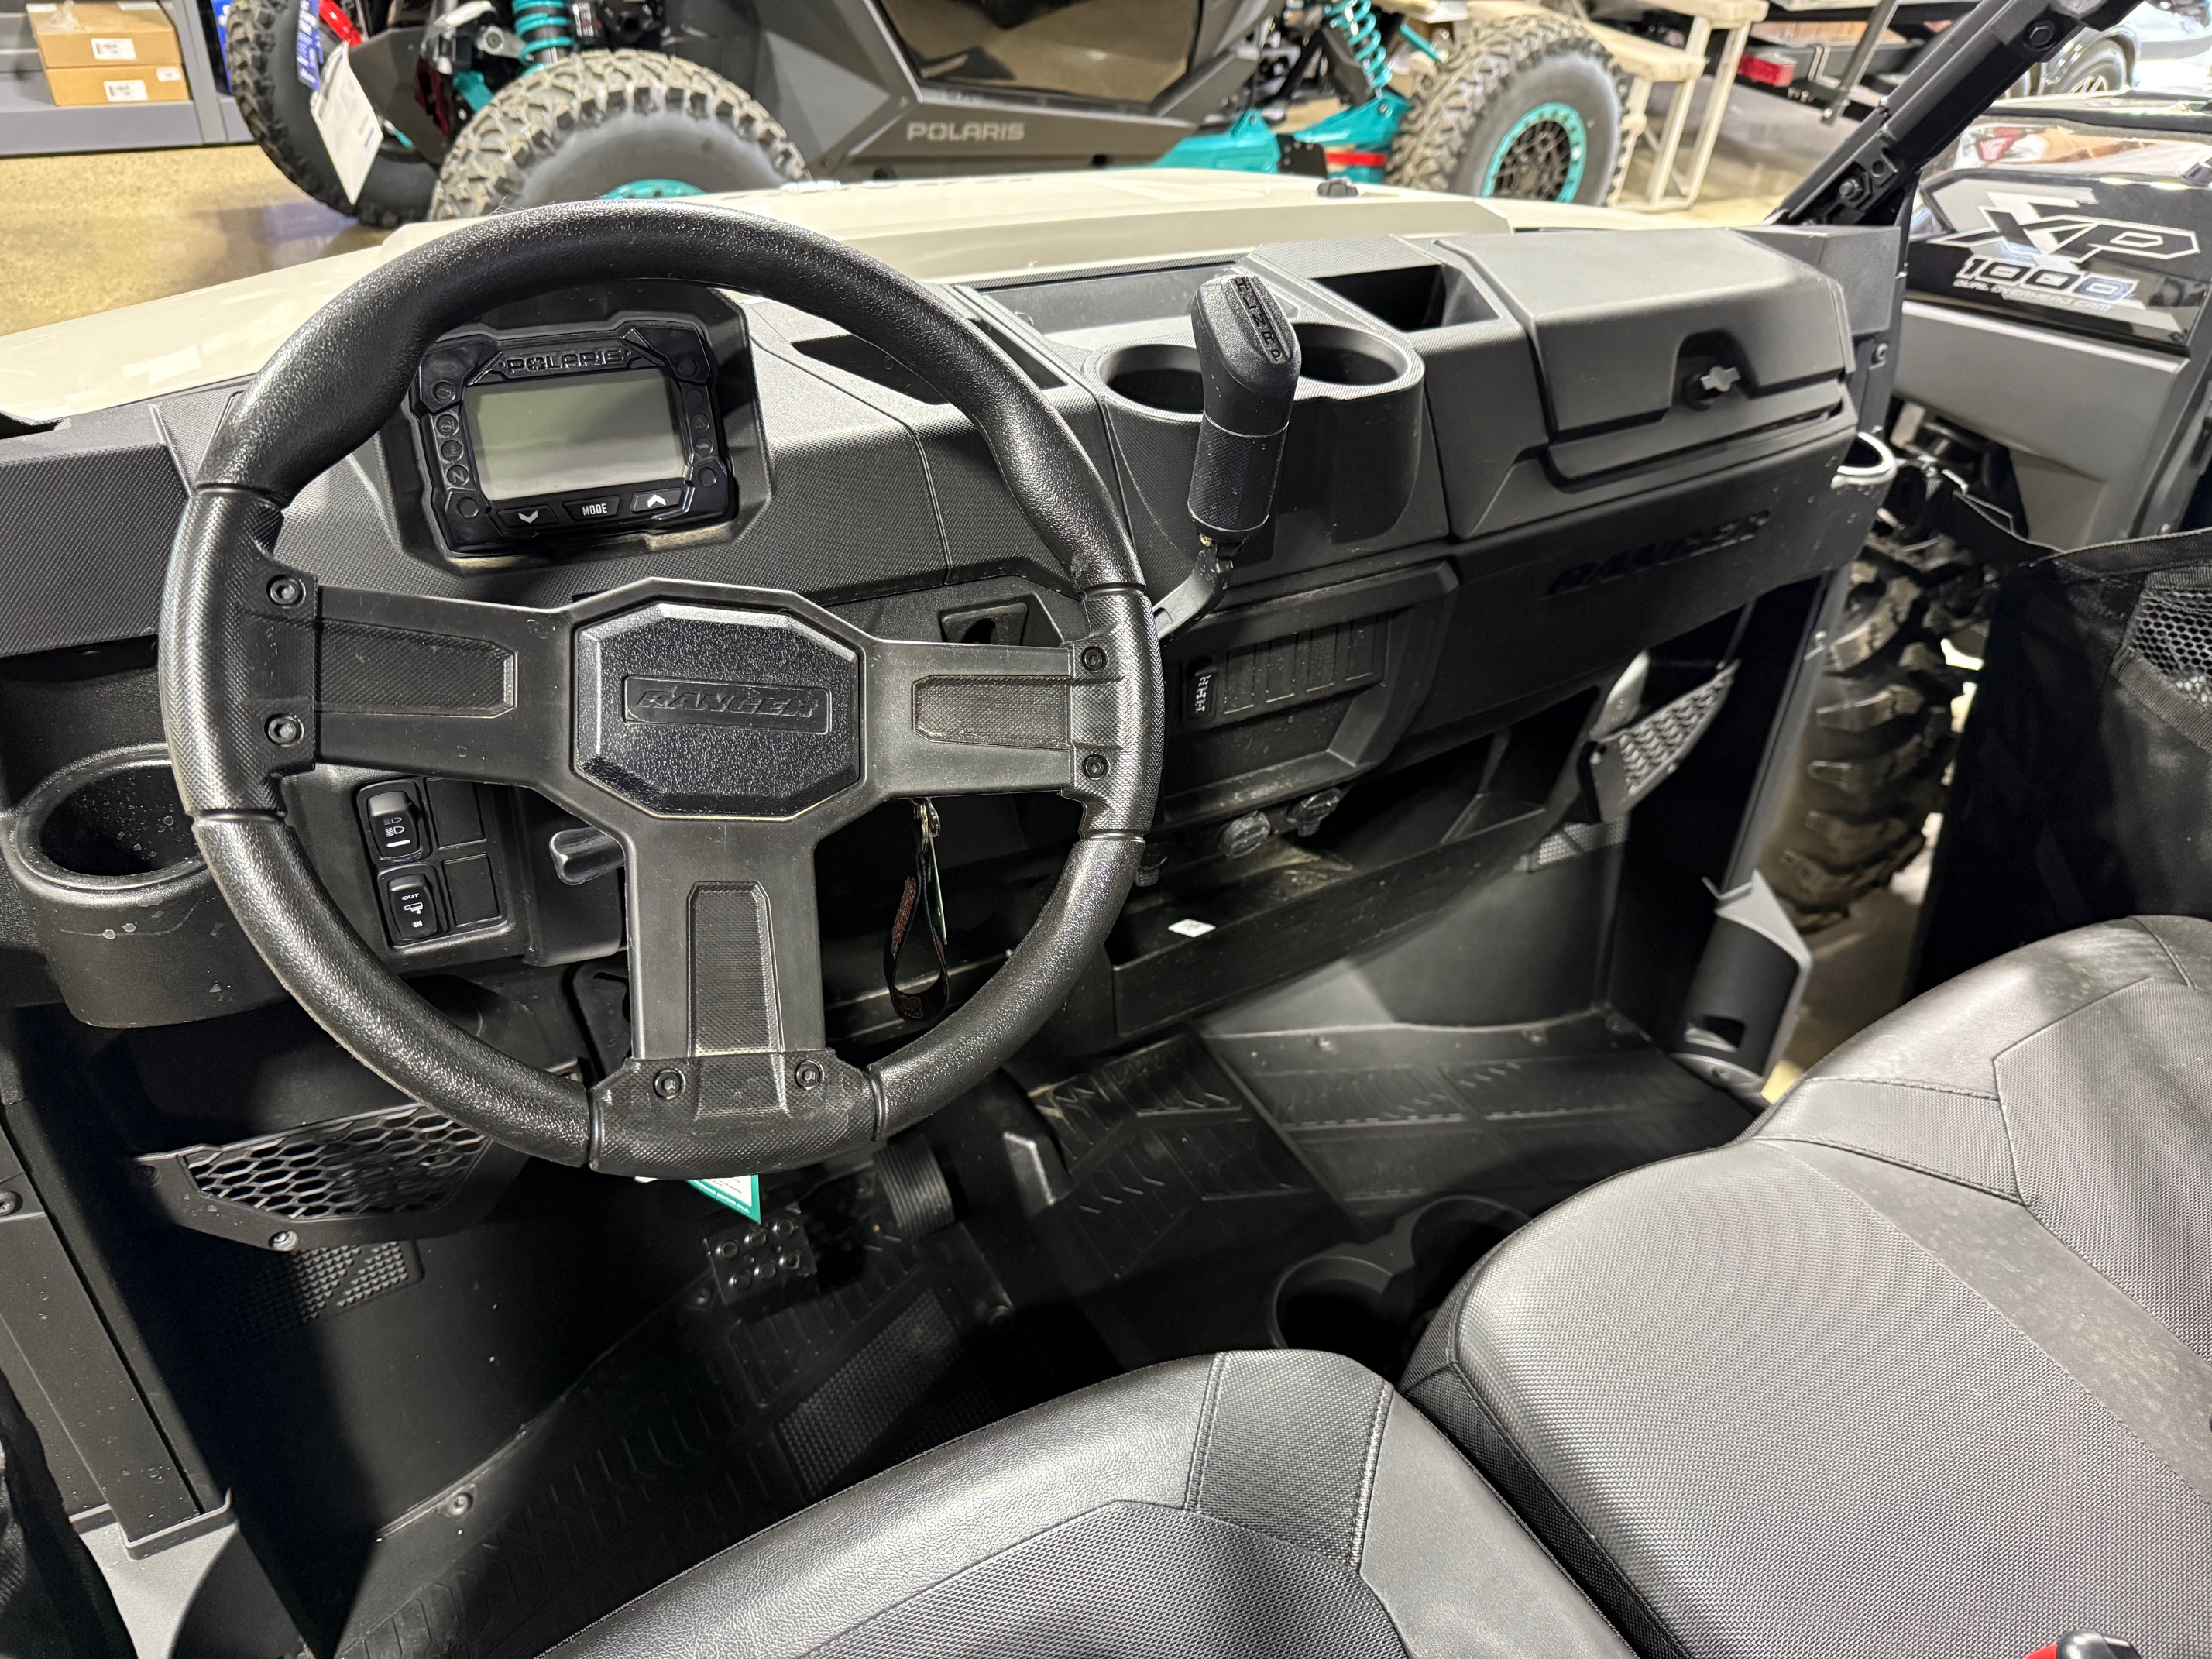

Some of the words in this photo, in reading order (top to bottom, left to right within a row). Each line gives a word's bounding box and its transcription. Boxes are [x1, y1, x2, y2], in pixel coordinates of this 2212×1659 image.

[906, 122, 1025, 142] POLARIS
[1927, 204, 2201, 265] XP
[1954, 254, 2140, 304] 1000
[506, 349, 626, 375] POLARIS
[582, 503, 608, 516] MODE
[635, 689, 819, 718] RANGER
[401, 892, 420, 901] OUT
